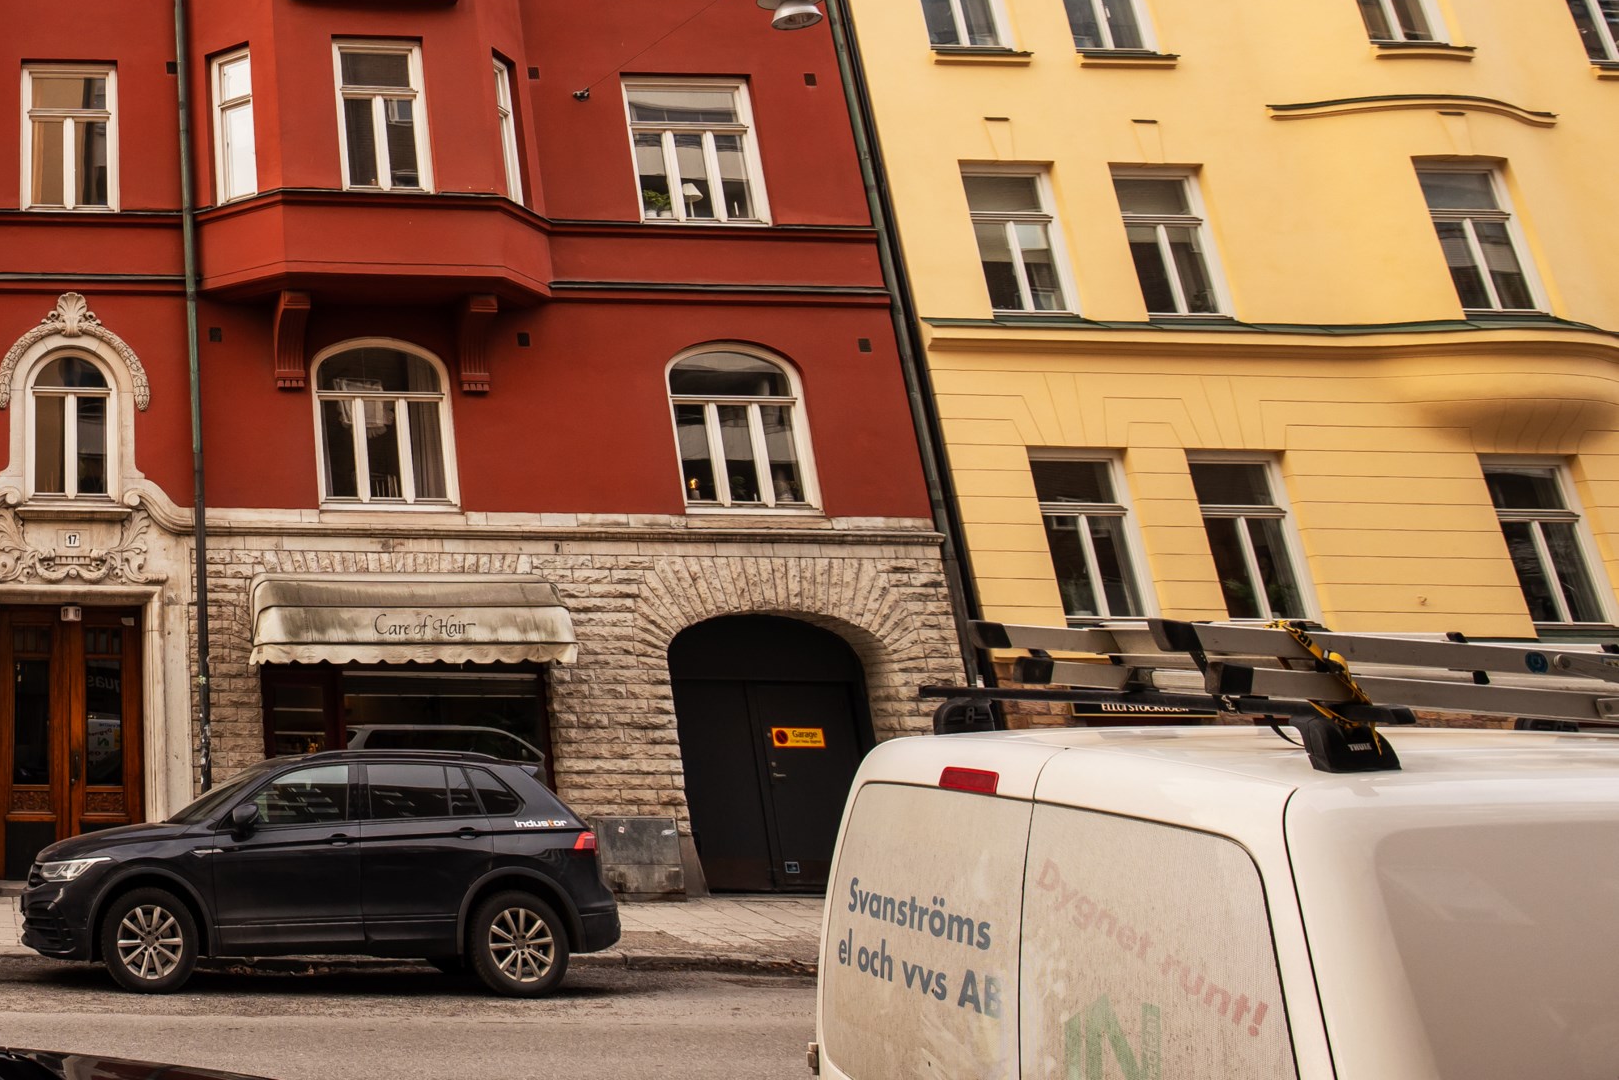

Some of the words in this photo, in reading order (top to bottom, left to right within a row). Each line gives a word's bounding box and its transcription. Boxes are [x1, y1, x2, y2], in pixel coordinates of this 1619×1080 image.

[68, 534, 77, 545] 17
[374, 613, 410, 635] Care
[414, 614, 433, 637] of
[433, 614, 476, 637] Hair
[792, 730, 818, 739] Garage
[1347, 742, 1372, 752] THULE
[514, 819, 567, 828] Industor
[848, 877, 991, 950] Svanströms
[1036, 858, 1154, 959] Dygnet
[1160, 953, 1269, 1037] runt!
[838, 928, 853, 966] el
[857, 938, 893, 983] och
[902, 960, 947, 1001] vvs
[957, 969, 1003, 1019] AB
